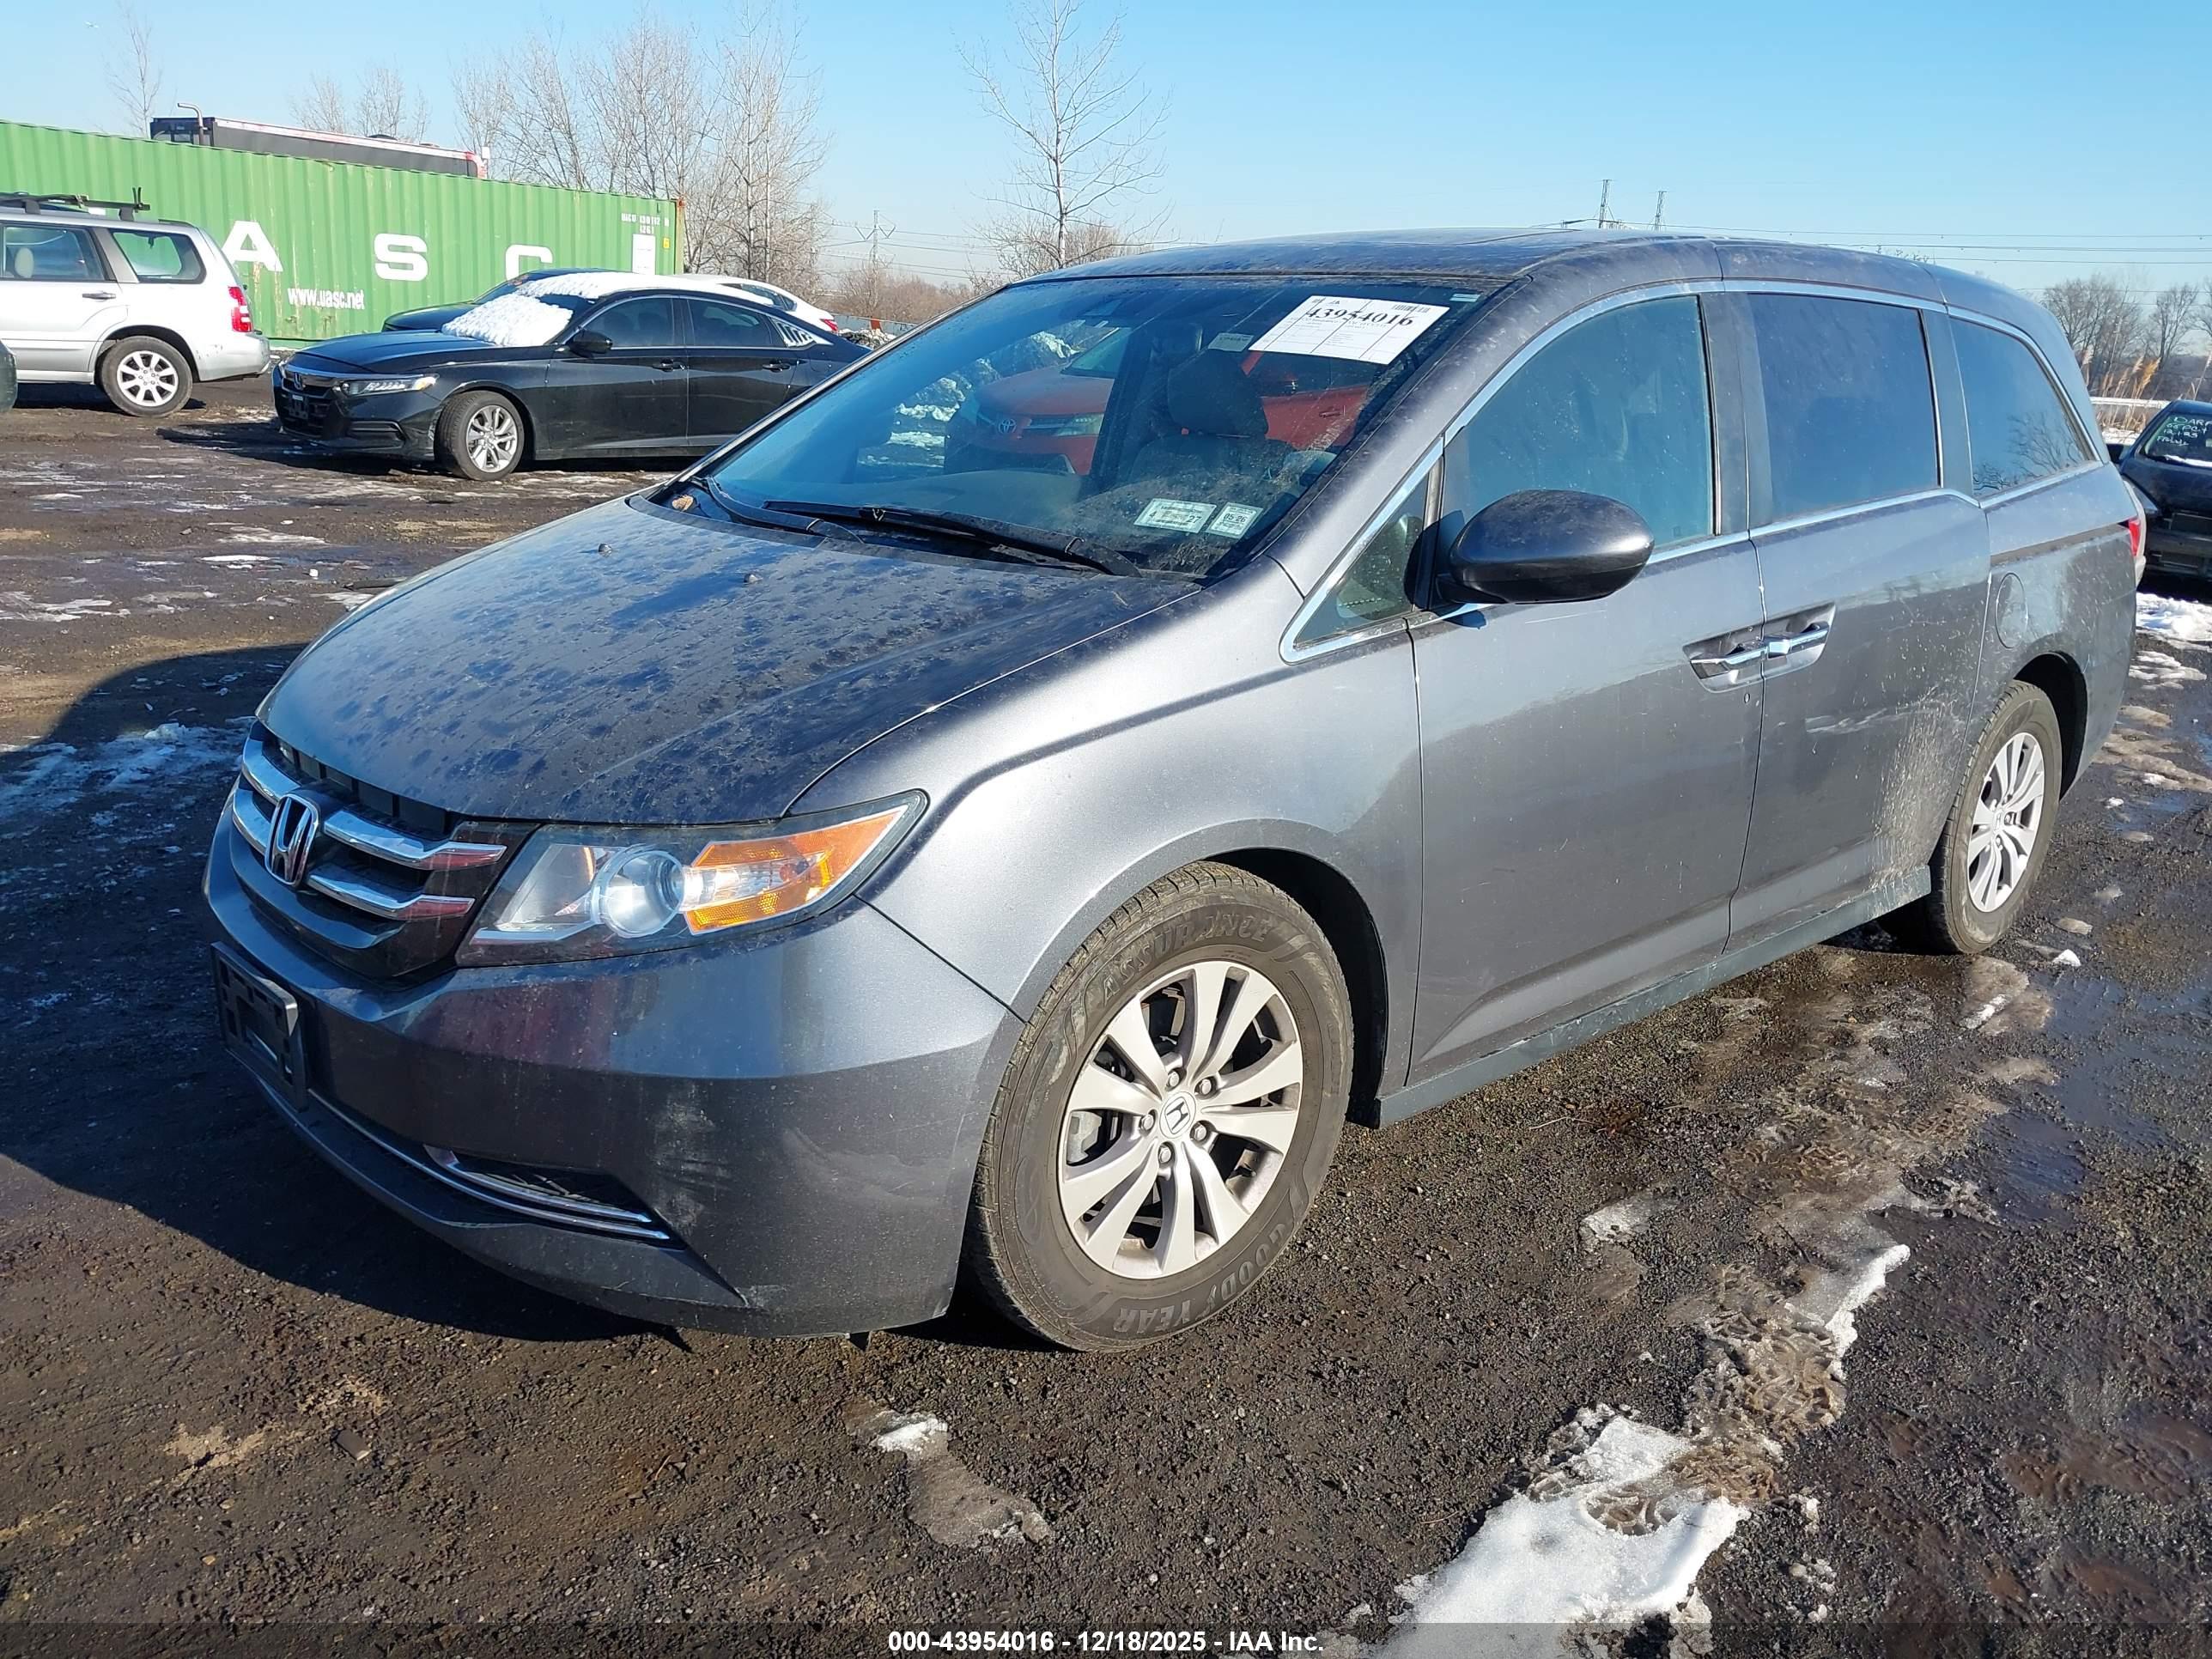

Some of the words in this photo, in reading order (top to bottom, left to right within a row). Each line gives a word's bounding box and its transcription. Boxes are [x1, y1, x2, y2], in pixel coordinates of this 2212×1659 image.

[287, 288, 365, 309] www.uasc.net
[1306, 307, 1414, 326] 43954016
[1186, 514, 1202, 524] 27
[1103, 912, 1273, 1006] ASSURANCE
